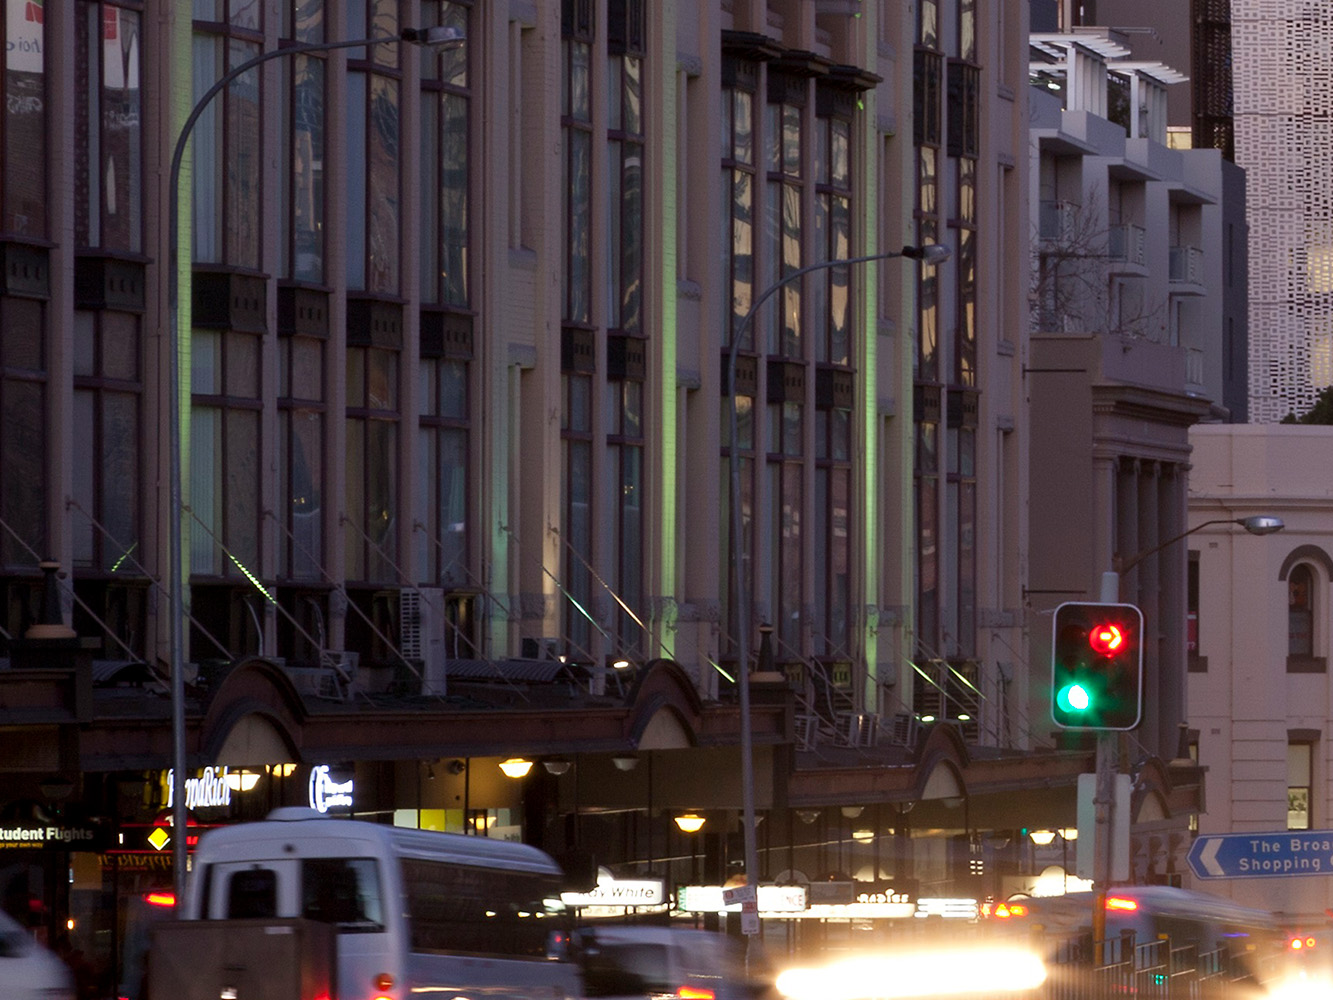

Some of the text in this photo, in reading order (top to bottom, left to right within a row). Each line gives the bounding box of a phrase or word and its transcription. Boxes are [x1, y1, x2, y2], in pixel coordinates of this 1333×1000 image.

[0, 827, 94, 843] tudent Flights
[1250, 840, 1280, 853] The
[1239, 857, 1321, 872] Shopping
[612, 887, 655, 898] White
